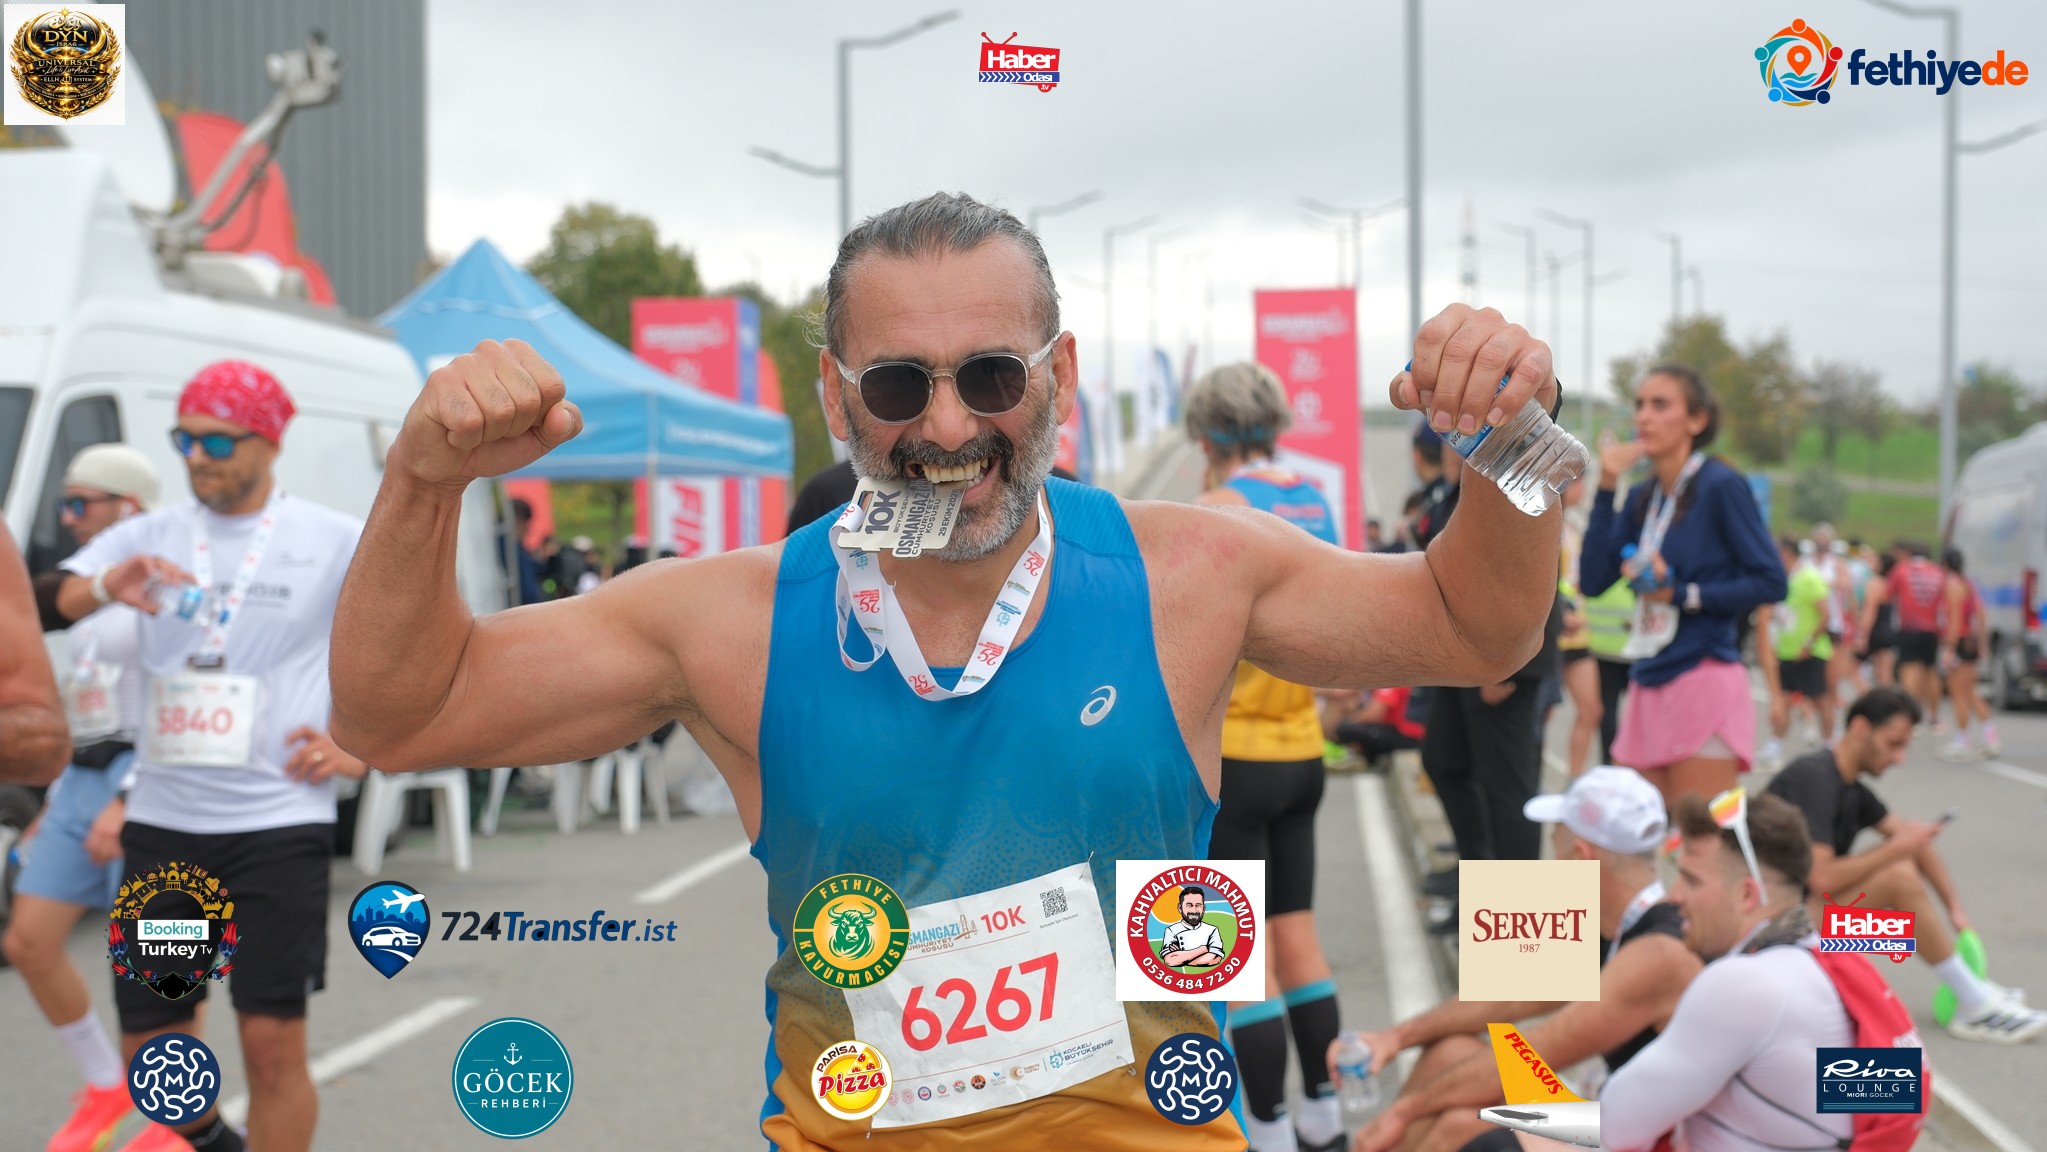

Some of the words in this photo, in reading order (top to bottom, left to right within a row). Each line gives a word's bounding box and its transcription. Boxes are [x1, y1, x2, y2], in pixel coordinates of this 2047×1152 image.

[864, 490, 901, 534] 10K
[938, 526, 947, 536] 29
[980, 905, 1027, 934] 10K
[901, 951, 1059, 1052] 6267
